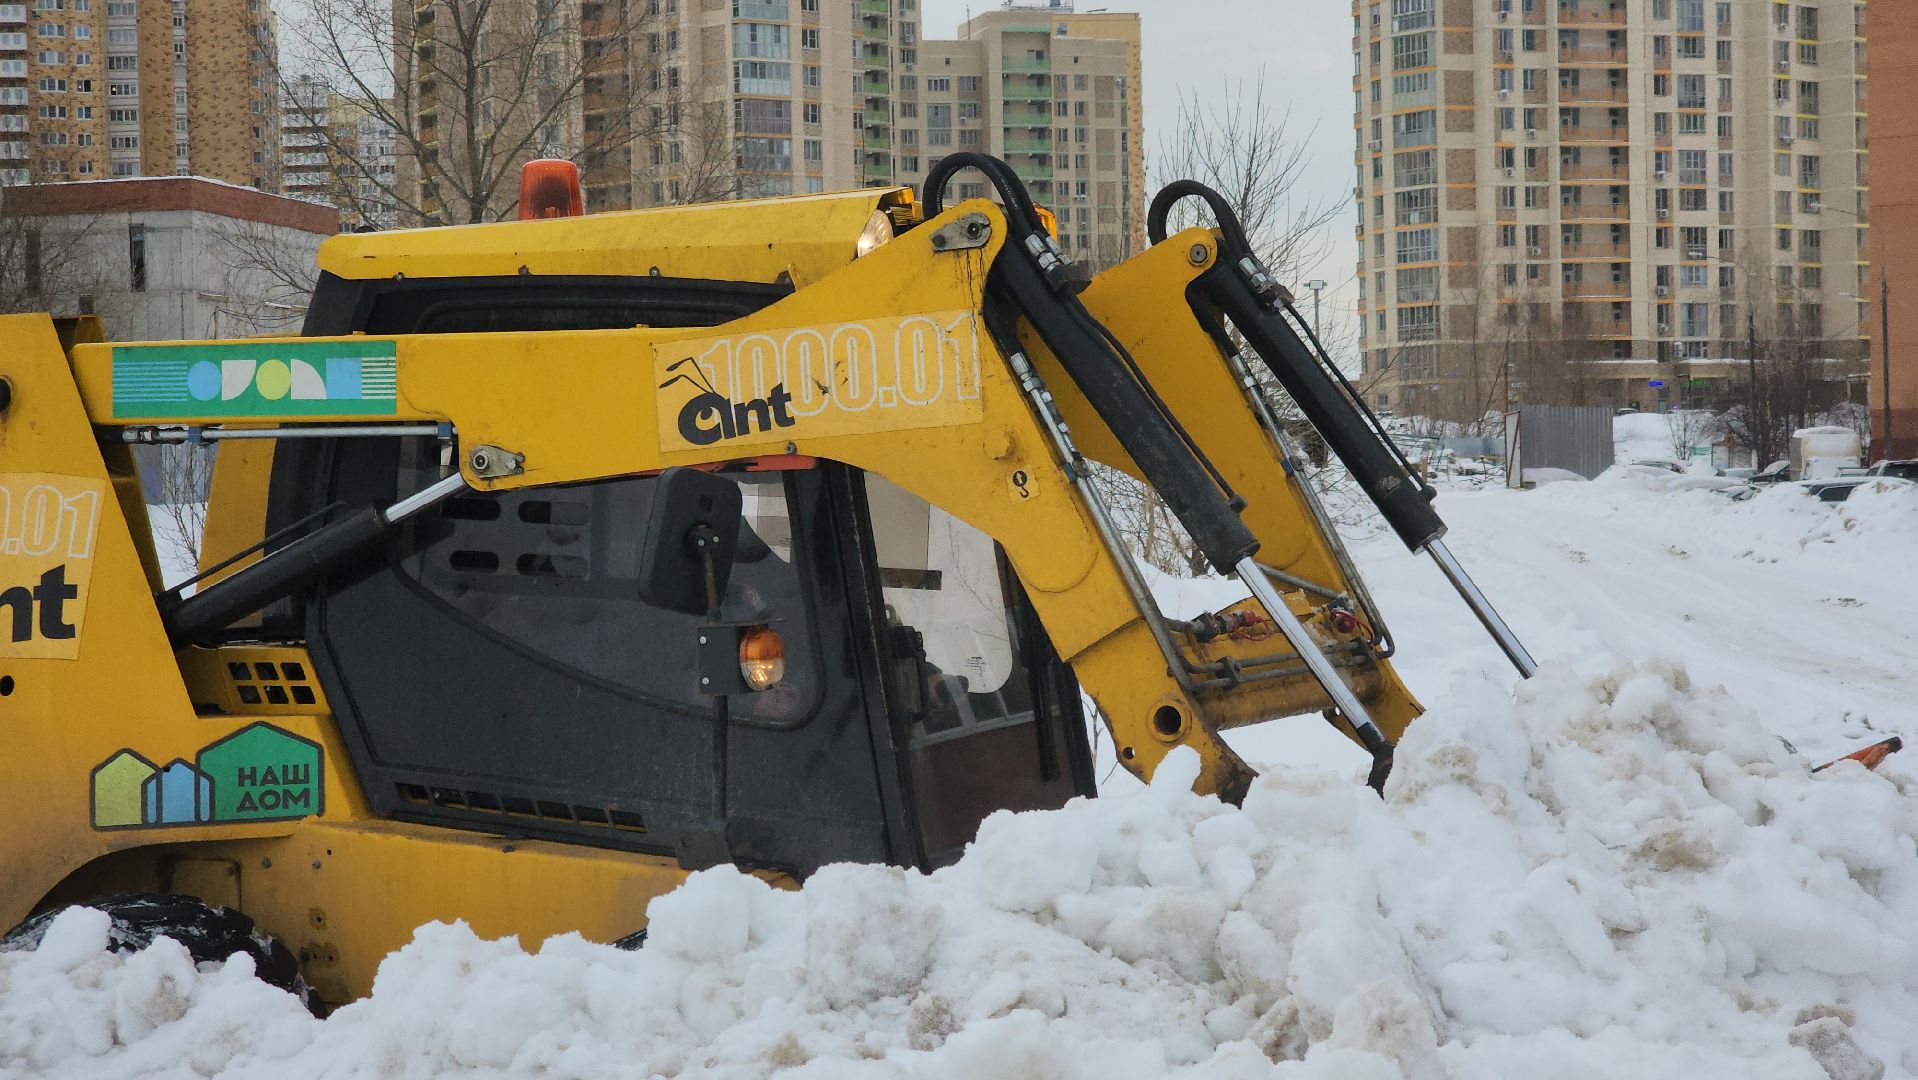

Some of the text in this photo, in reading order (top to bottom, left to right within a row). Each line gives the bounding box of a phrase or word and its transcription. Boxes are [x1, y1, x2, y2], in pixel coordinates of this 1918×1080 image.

[699, 311, 981, 425] 1000.01
[677, 381, 796, 446] ant
[0, 484, 98, 558] .01
[236, 787, 311, 813] ДОМ
[237, 763, 310, 788] НАШ
